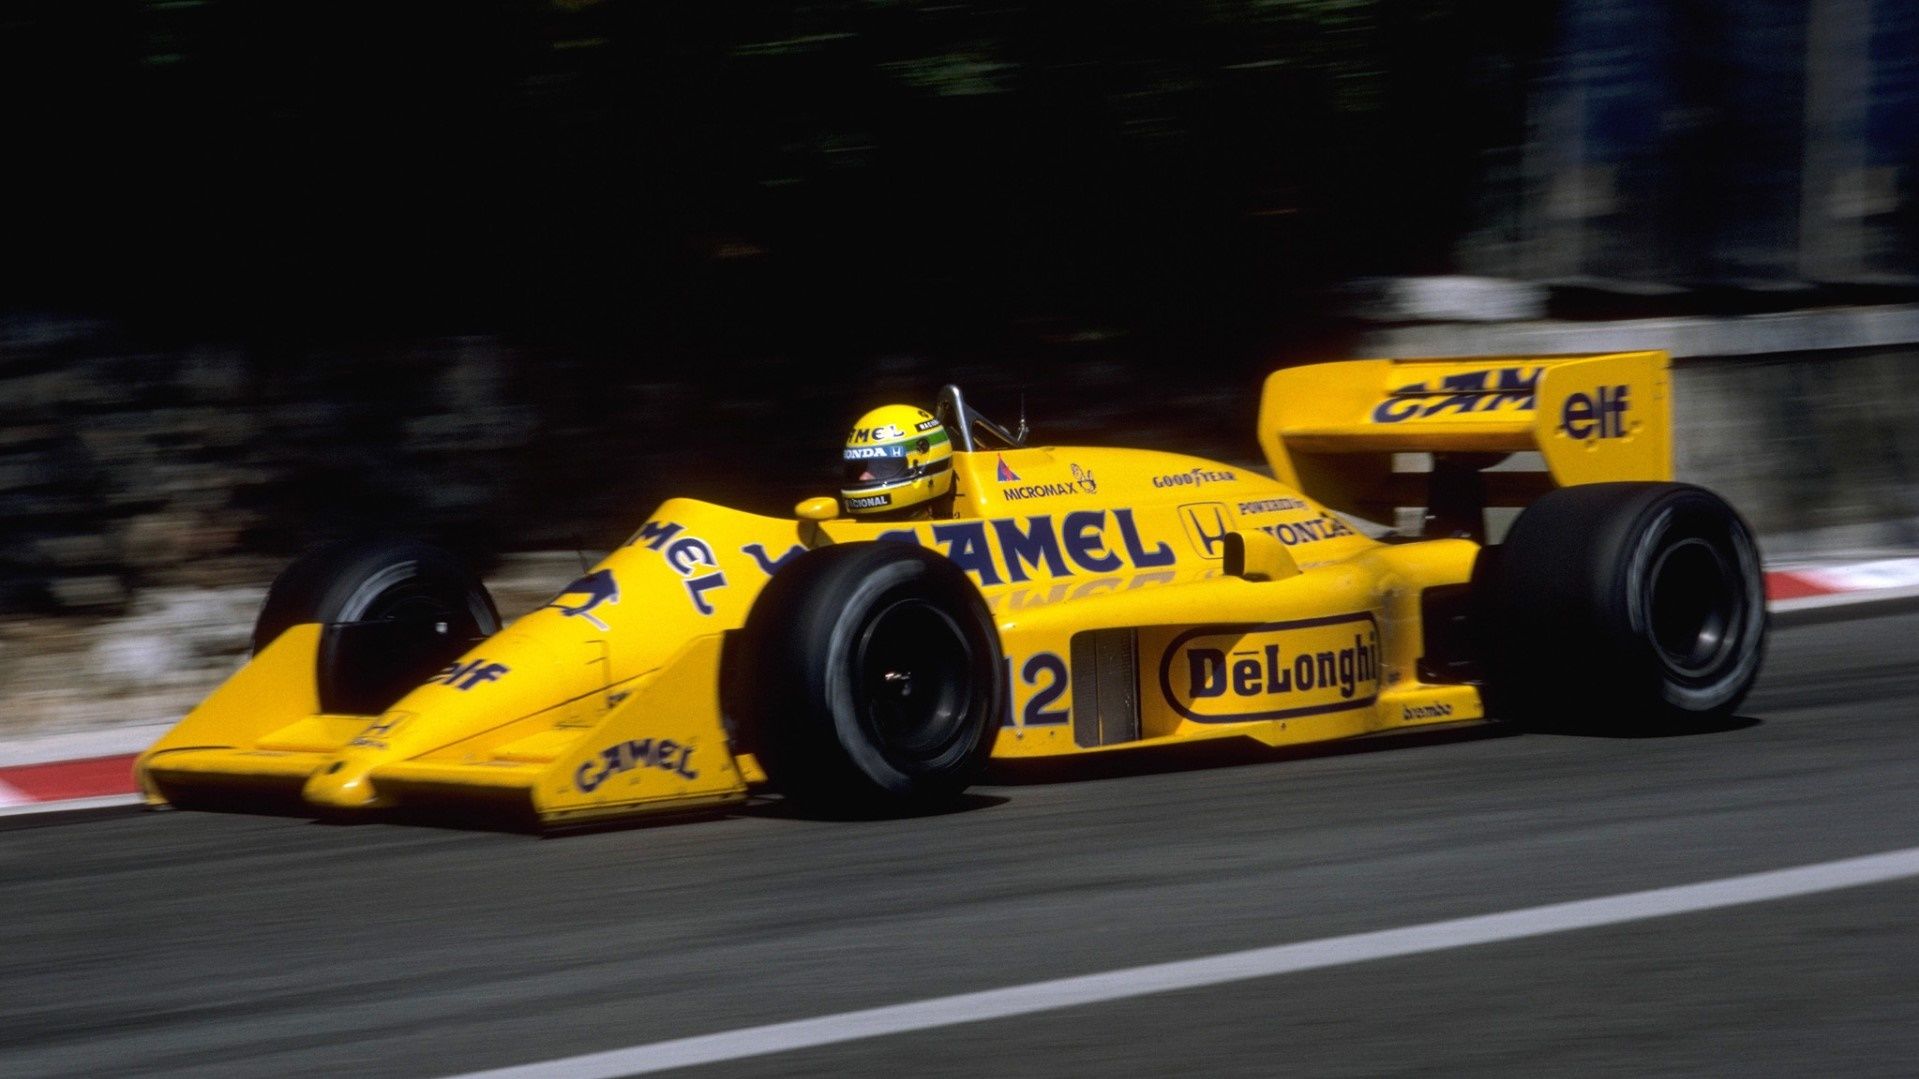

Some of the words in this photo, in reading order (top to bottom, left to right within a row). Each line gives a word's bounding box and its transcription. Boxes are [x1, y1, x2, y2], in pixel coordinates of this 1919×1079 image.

[1563, 384, 1629, 440] elf
[1003, 482, 1078, 501] MICROMAX
[575, 738, 699, 793] CAMEL
